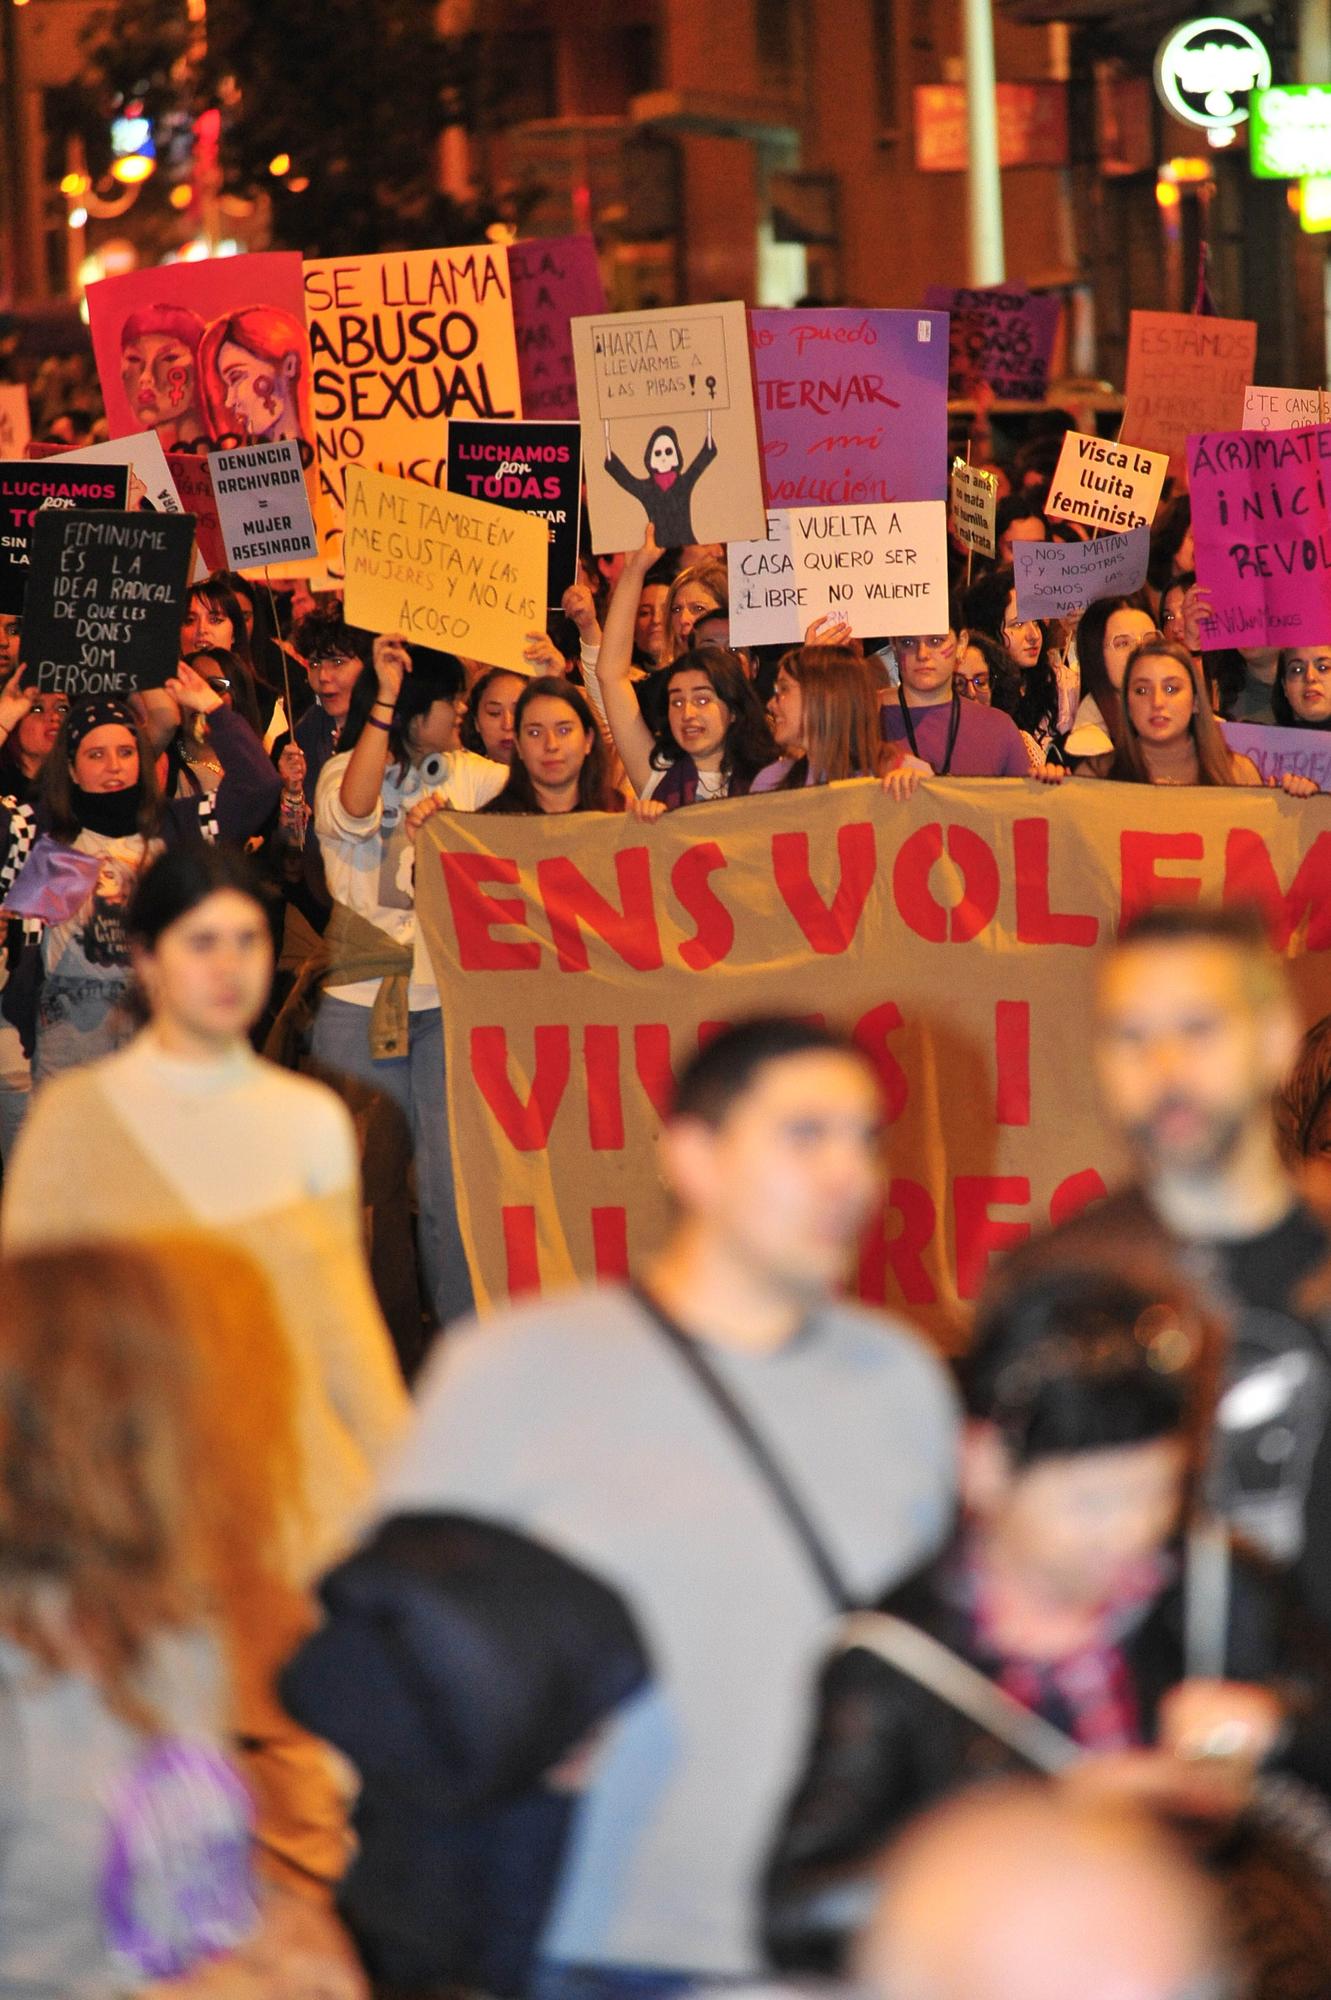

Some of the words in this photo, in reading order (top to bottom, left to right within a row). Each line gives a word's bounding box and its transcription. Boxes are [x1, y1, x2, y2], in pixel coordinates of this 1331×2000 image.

[303, 267, 362, 312] SE
[381, 253, 507, 308] LLAMA
[309, 310, 478, 369] ABUSO
[670, 328, 692, 350] DE
[603, 355, 680, 376] LLEVARME
[691, 353, 703, 366] A
[314, 362, 515, 422] SEXUAL
[608, 382, 634, 398] LAS
[1246, 394, 1279, 412] ¿TE
[316, 427, 364, 464] NO
[458, 444, 570, 463] LUCHAMOS
[1079, 439, 1128, 469] Visca
[1133, 453, 1152, 475] la
[217, 448, 292, 472] DENUNCIA
[495, 459, 532, 480] por
[2, 482, 116, 499] LUCHAMOS
[217, 469, 300, 494] ARCHIVADA
[466, 475, 562, 499] TODAS
[1080, 469, 1134, 500] lluita
[39, 497, 76, 511] por
[352, 481, 367, 517] A
[379, 491, 408, 525] MI
[418, 501, 515, 547] TAMBIÉN
[1052, 492, 1147, 529] feminista
[64, 522, 168, 550] FEMINISME
[243, 516, 292, 536] MUJER
[798, 514, 877, 539] VUELTA
[888, 512, 902, 535] A
[0, 536, 27, 548] SIN
[232, 536, 311, 560] ASESINADA
[351, 527, 381, 553] ME
[386, 532, 484, 578] GUSTAN
[488, 559, 519, 584] LAS
[1035, 549, 1067, 562] NOS
[1082, 535, 1129, 557] MATAN
[60, 545, 86, 573] ÉS
[111, 555, 142, 575] LA
[741, 553, 794, 577] CASA
[885, 549, 917, 567] SER
[1061, 554, 1125, 576] NOSOTRAS
[1228, 535, 1331, 579] REVOL
[53, 576, 99, 599] IDEA
[110, 578, 176, 604] RADICAL
[353, 555, 434, 592] MUJERES
[446, 576, 460, 598] Y
[470, 580, 499, 609] NO
[504, 593, 536, 620] LAS
[746, 587, 808, 609] LIBRE
[828, 583, 854, 604] NO
[1033, 583, 1083, 596] SOMOS
[53, 601, 77, 619] DE
[87, 604, 116, 620] QUE
[122, 607, 147, 621] LES
[399, 600, 470, 639] ACOSO
[75, 619, 132, 643] DONES
[79, 643, 117, 669] SOM
[38, 661, 139, 694] PERSONES
[440, 841, 736, 974] ENS
[771, 817, 1331, 956] VOLEM
[995, 1000, 1031, 1126] I
